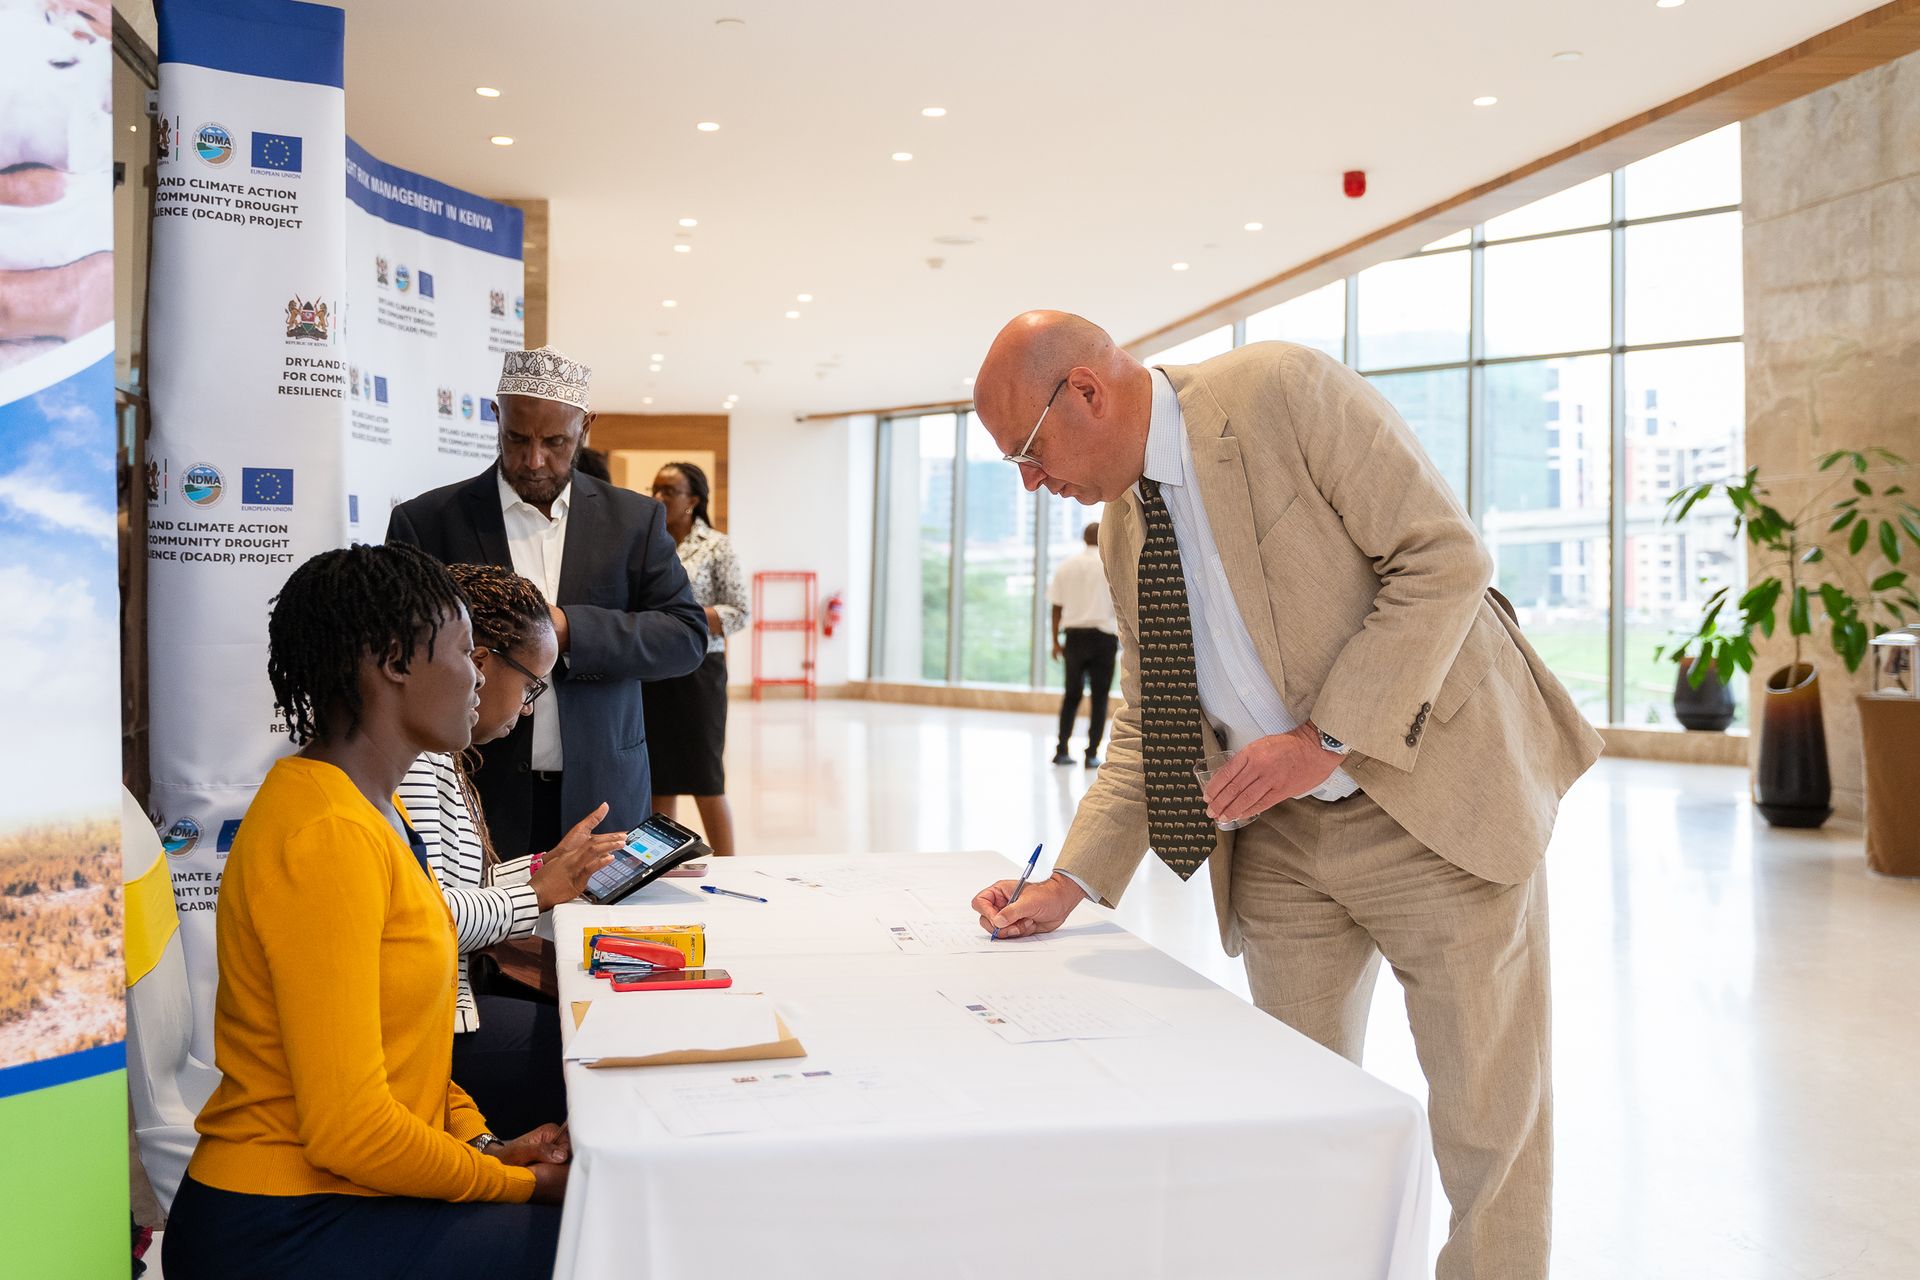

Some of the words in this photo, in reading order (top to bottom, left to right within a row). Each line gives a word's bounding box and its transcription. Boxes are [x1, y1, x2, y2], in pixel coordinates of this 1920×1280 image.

[200, 132, 231, 146] NDMA
[250, 168, 280, 177] EUROPEAN
[189, 178, 244, 195] CLIMATE
[248, 187, 297, 200] ACTION
[156, 192, 231, 207] COMMUNITY
[235, 199, 299, 214] DROUGHT
[370, 175, 444, 216] MANAGEMENT
[445, 203, 457, 221] IN
[459, 207, 494, 233] KENYA
[192, 208, 246, 226] (DCADR)
[249, 215, 303, 229] PROJECT
[285, 357, 340, 370] DRYLAND
[283, 371, 307, 381] FOR
[278, 385, 342, 398] RESILIENCE
[187, 474, 221, 485] NDMA
[177, 521, 235, 532] CLIMATE
[238, 524, 288, 533] ACTION
[149, 535, 221, 547] COMMUNITY
[225, 538, 290, 548] DROUGHT
[180, 551, 236, 565] (DCADR)
[239, 553, 294, 565] PROJECT
[168, 825, 199, 837] NDMA
